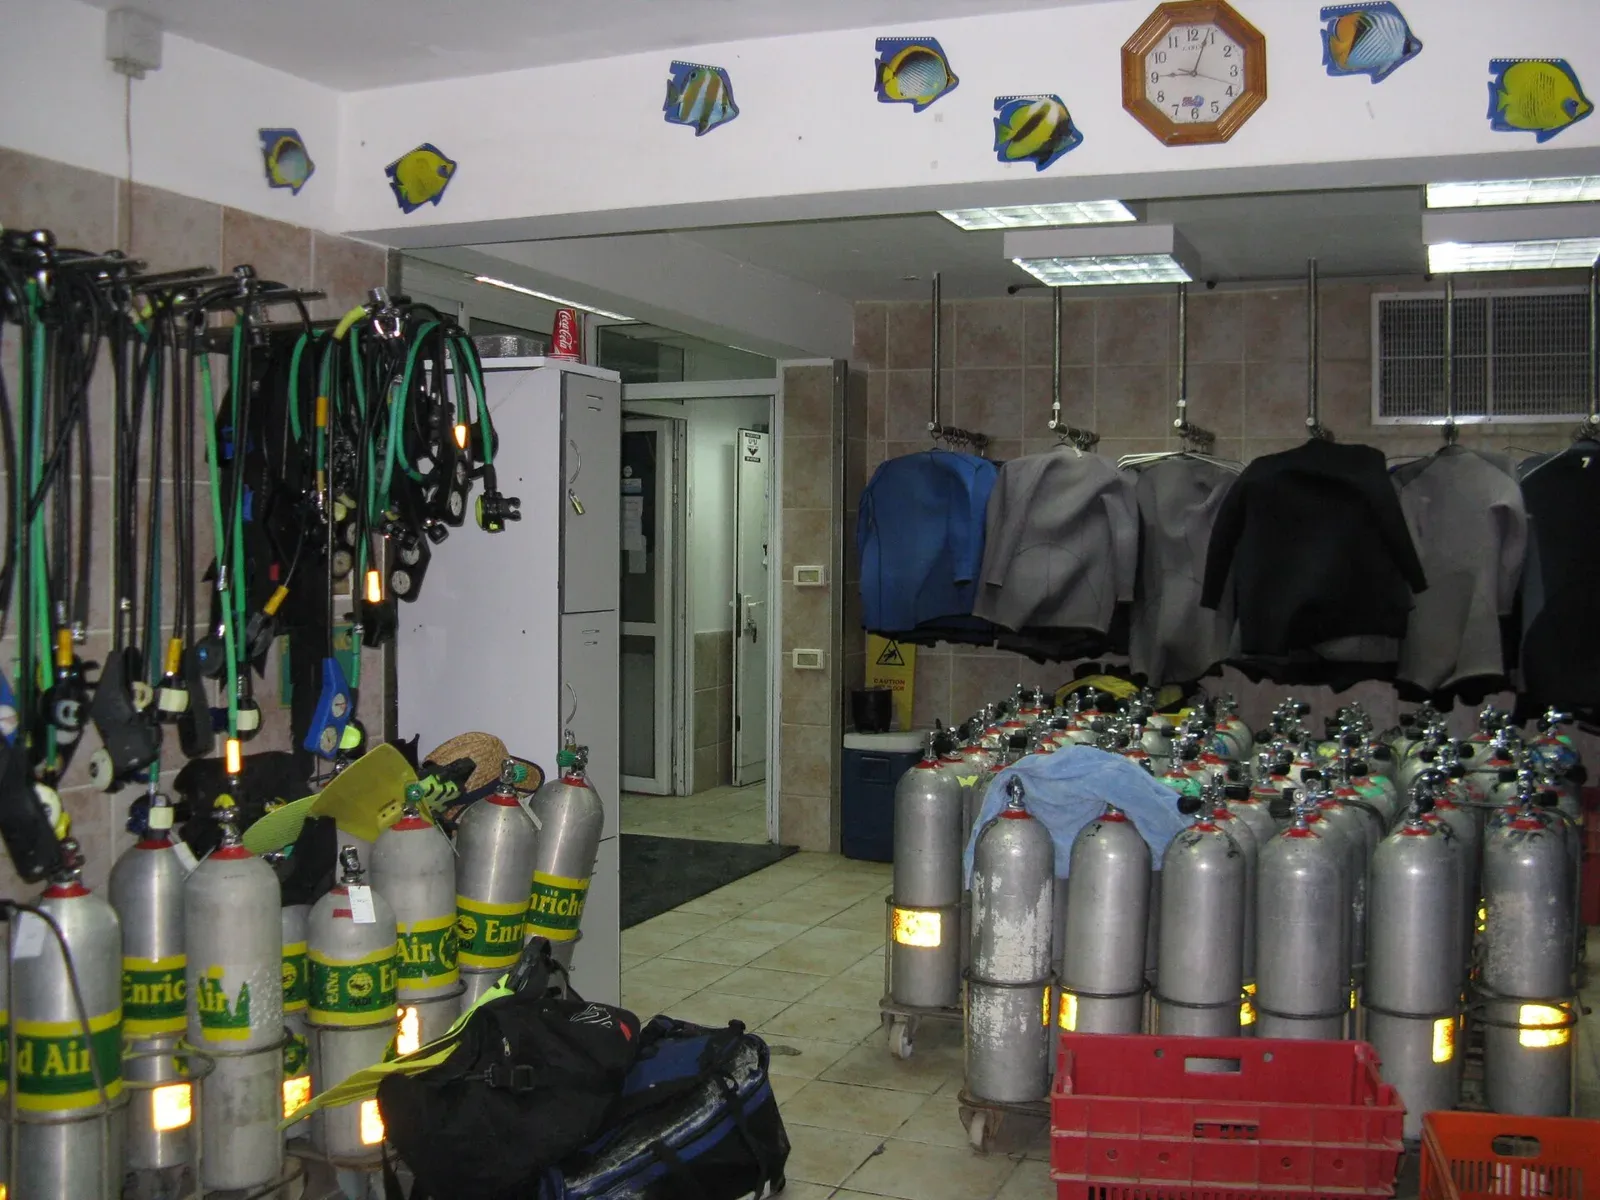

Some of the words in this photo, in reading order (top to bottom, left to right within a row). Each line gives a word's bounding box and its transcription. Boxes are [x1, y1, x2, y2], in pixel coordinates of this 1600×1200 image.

[1187, 28, 1199, 41] 12
[1210, 31, 1215, 44] 1
[1168, 36, 1179, 48] 11
[1224, 45, 1232, 57] 2
[1154, 51, 1166, 64] 10
[1230, 65, 1238, 77] 3
[1151, 72, 1159, 84] 9
[1156, 91, 1164, 102] 8
[1226, 85, 1233, 97] 4
[1172, 104, 1180, 116] 7
[1191, 108, 1199, 119] 6
[1211, 102, 1219, 113] 5
[1581, 457, 1591, 468] 7
[530, 890, 584, 917] nriche
[396, 934, 433, 963] Air
[41, 1040, 91, 1076] Air
